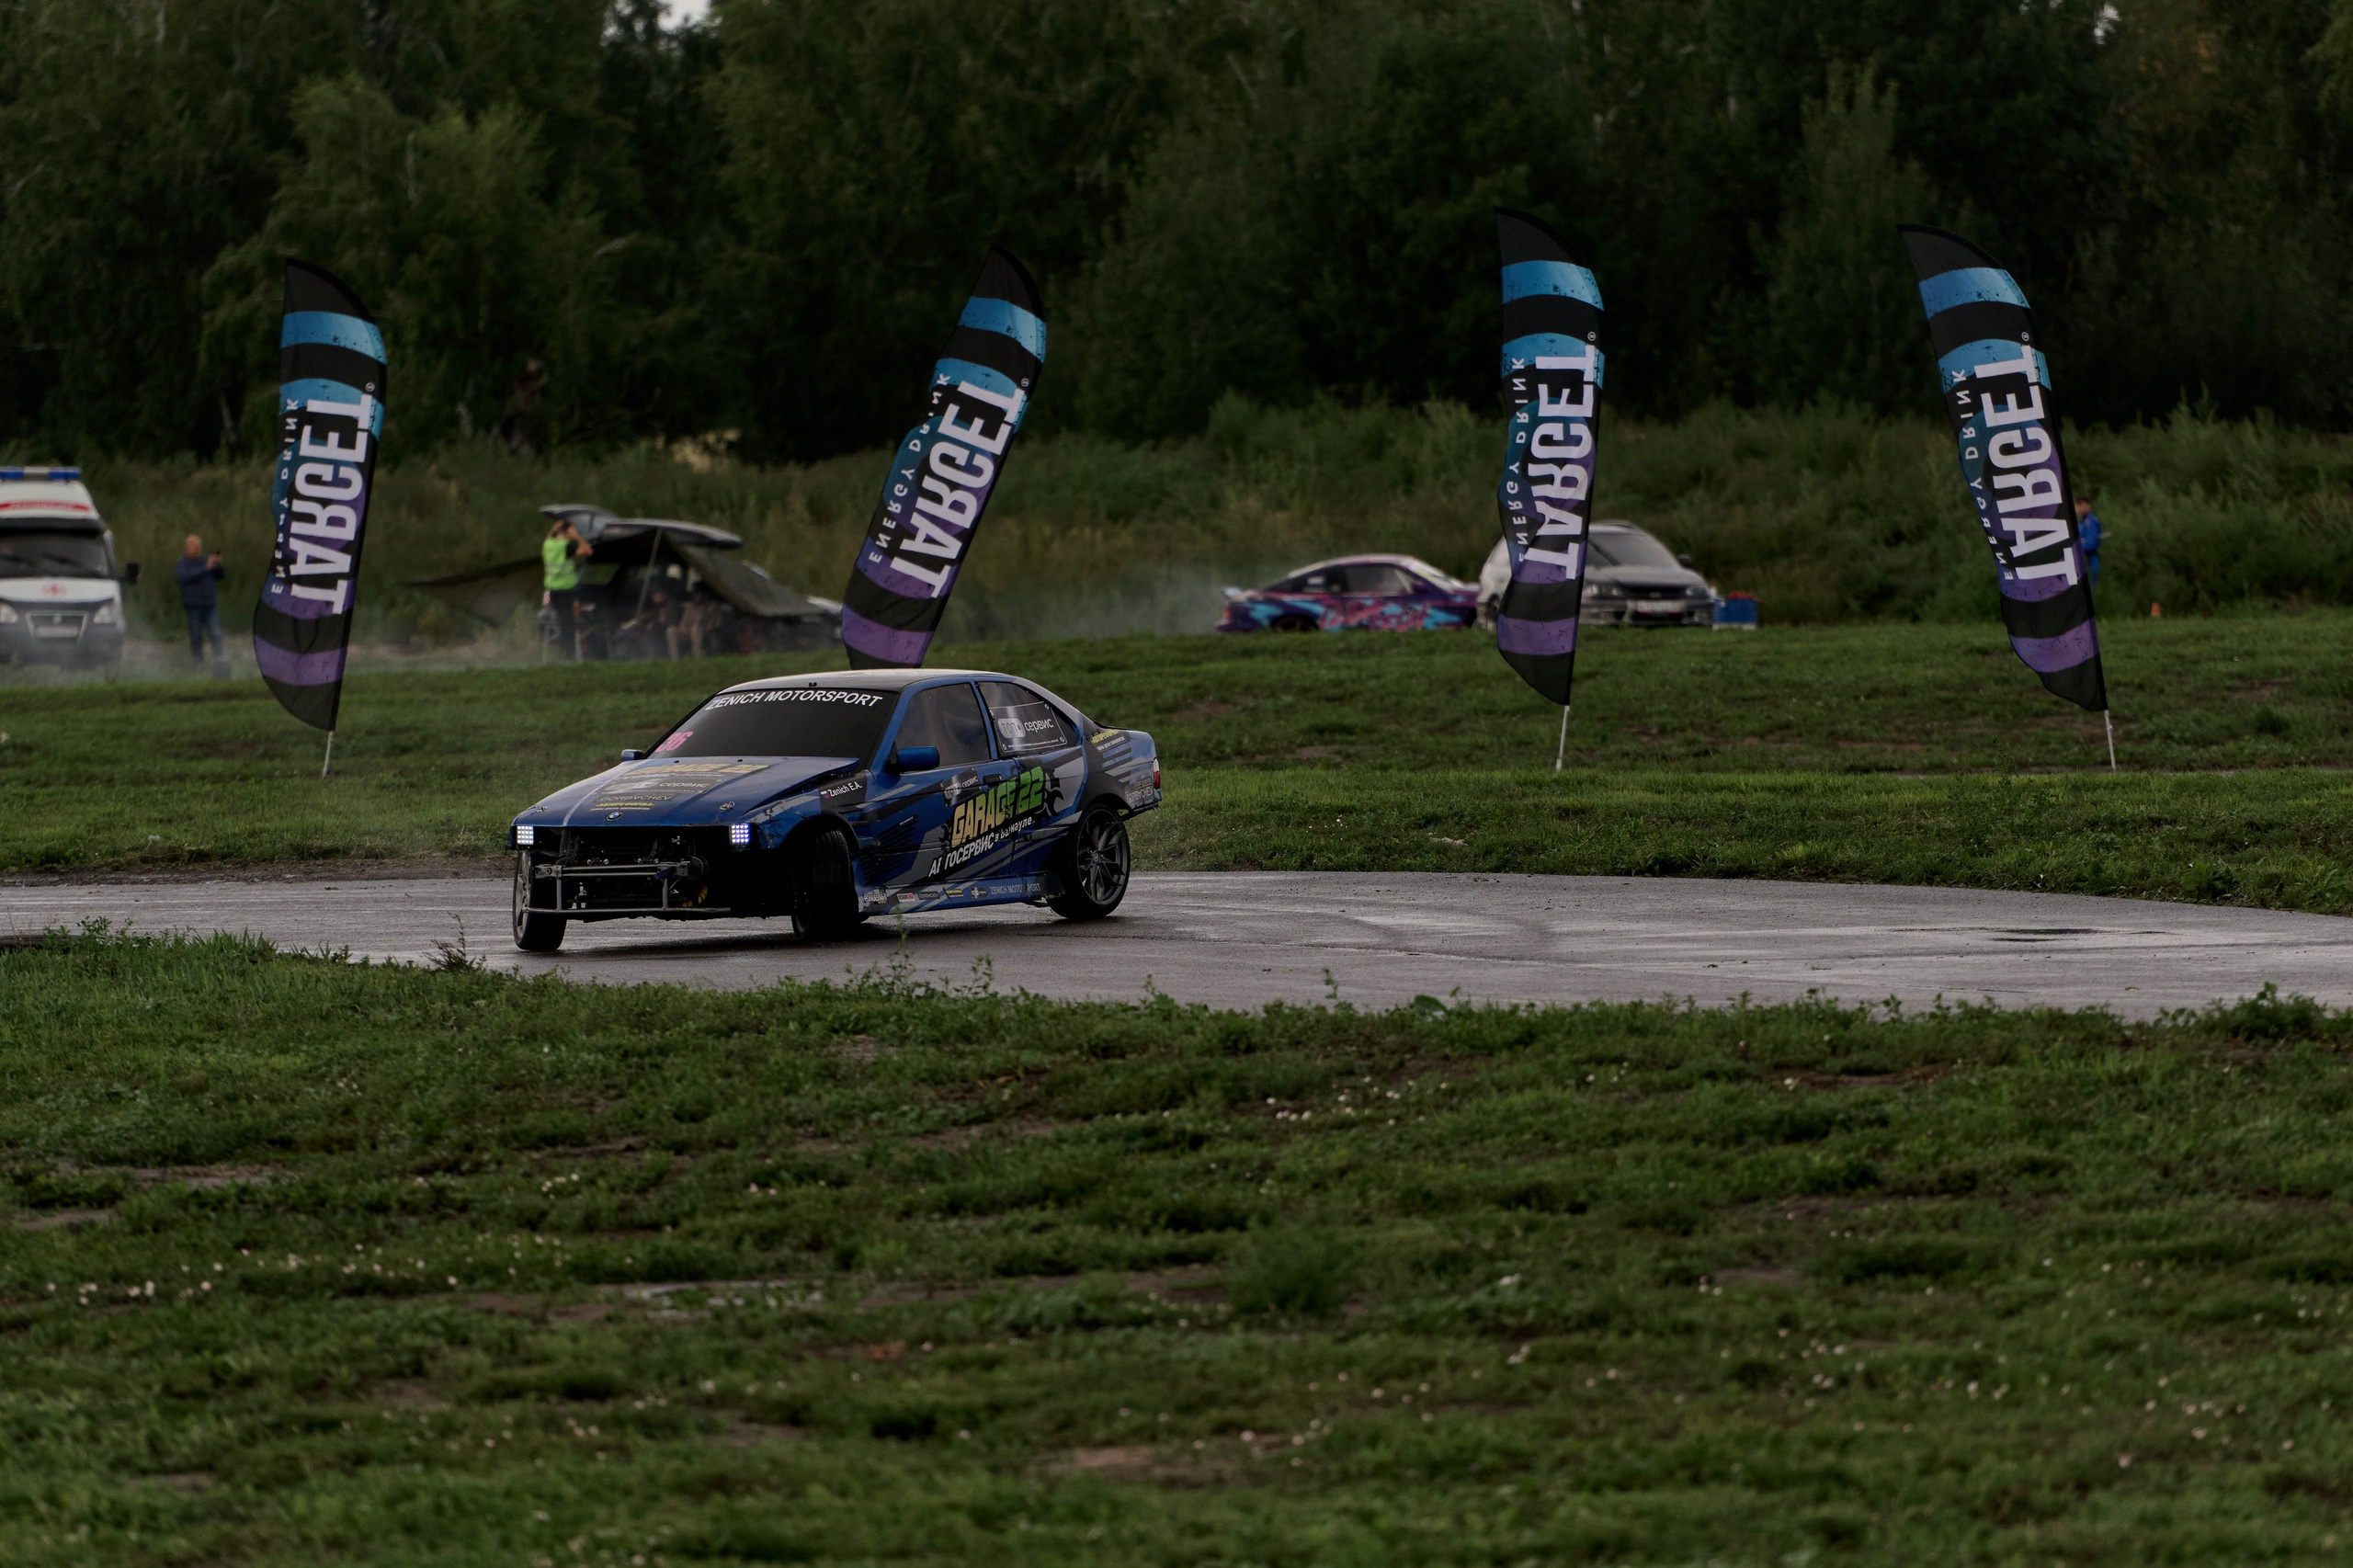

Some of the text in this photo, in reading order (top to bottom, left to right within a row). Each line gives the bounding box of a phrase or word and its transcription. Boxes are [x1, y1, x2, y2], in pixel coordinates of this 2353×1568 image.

[705, 690, 882, 710] ZENICH MOTORSPORT
[1024, 719, 1054, 733] сервис
[827, 781, 863, 797] Zenich E.A.
[951, 767, 1044, 847] GARAGE 22
[1008, 883, 1041, 893] MOTOPORT
